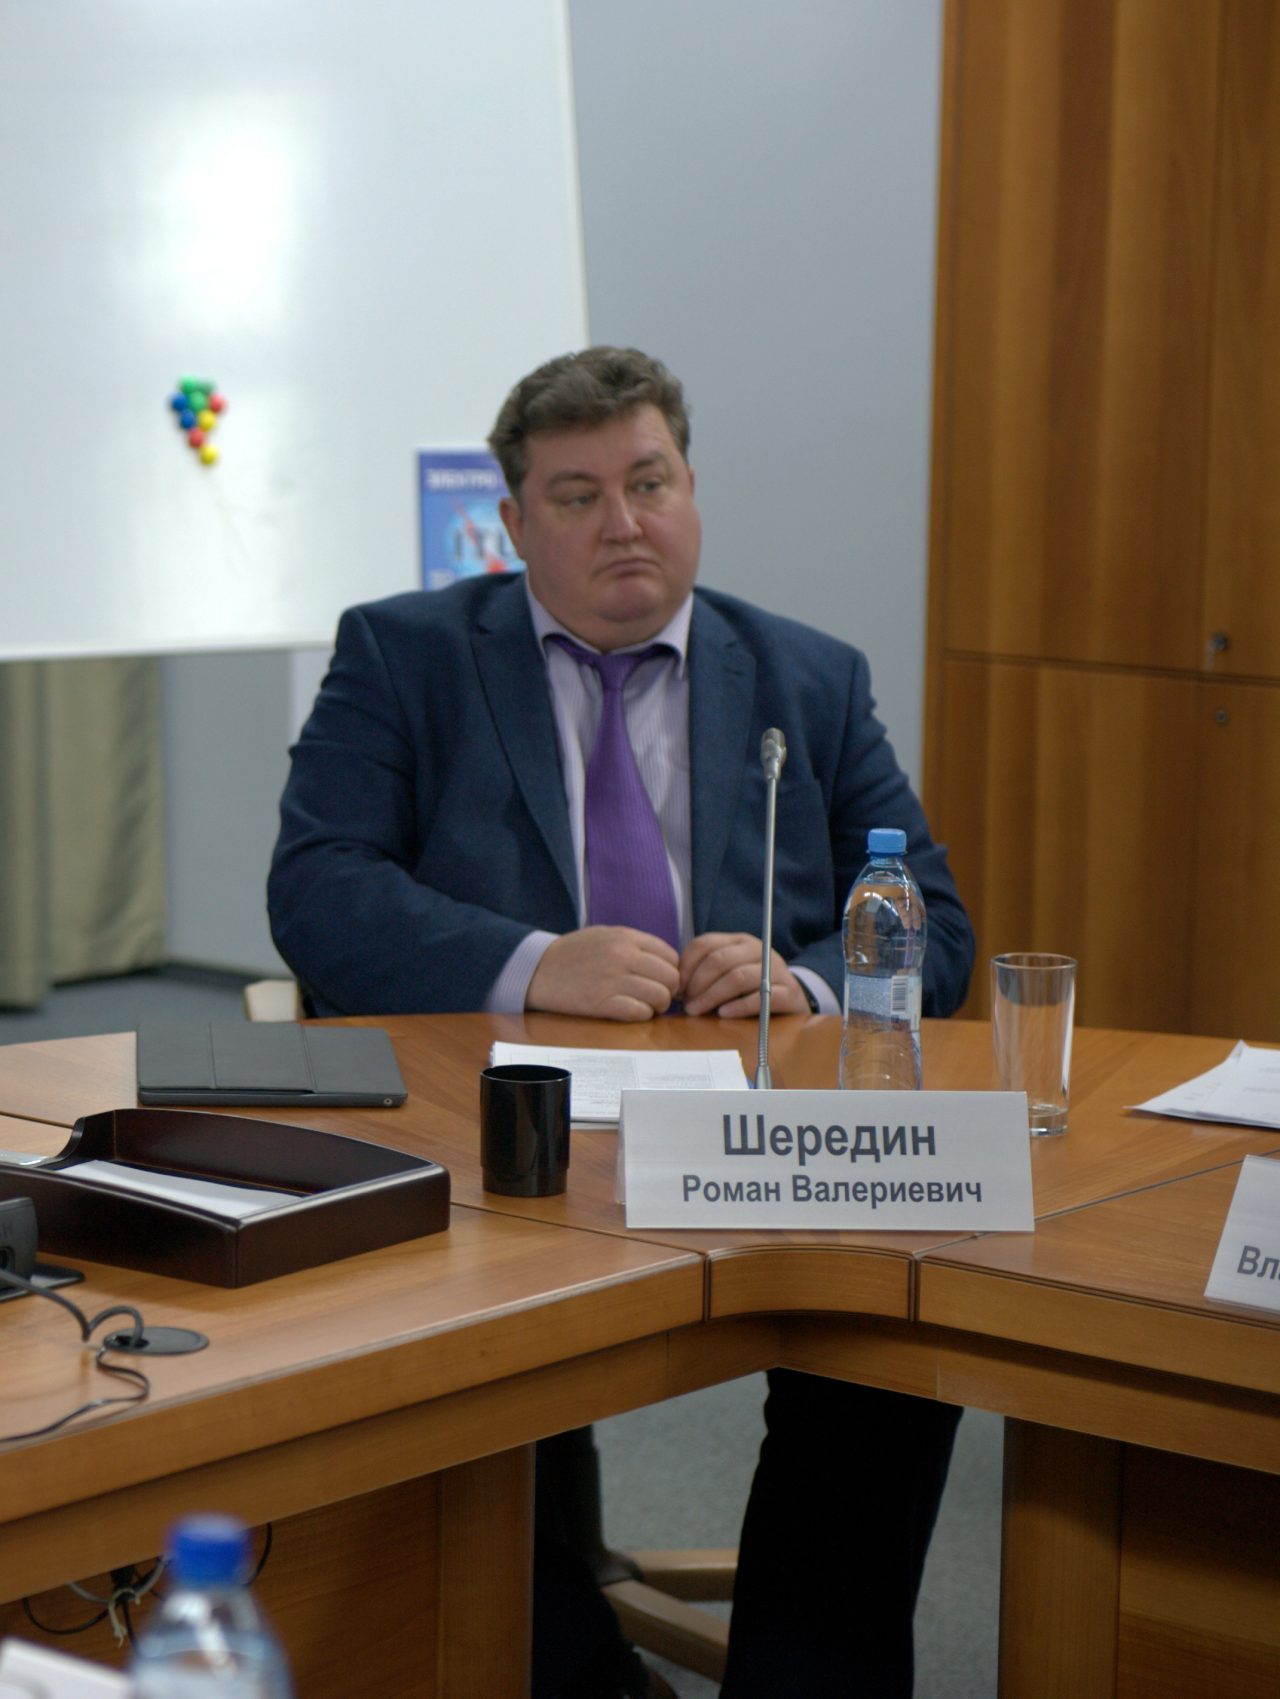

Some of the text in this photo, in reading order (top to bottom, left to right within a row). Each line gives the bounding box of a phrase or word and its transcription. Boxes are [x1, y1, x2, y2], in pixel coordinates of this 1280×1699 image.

[722, 1113, 937, 1167] Шередин
[682, 1174, 983, 1210] Роман Валериевич
[1236, 1244, 1280, 1280] Вл
